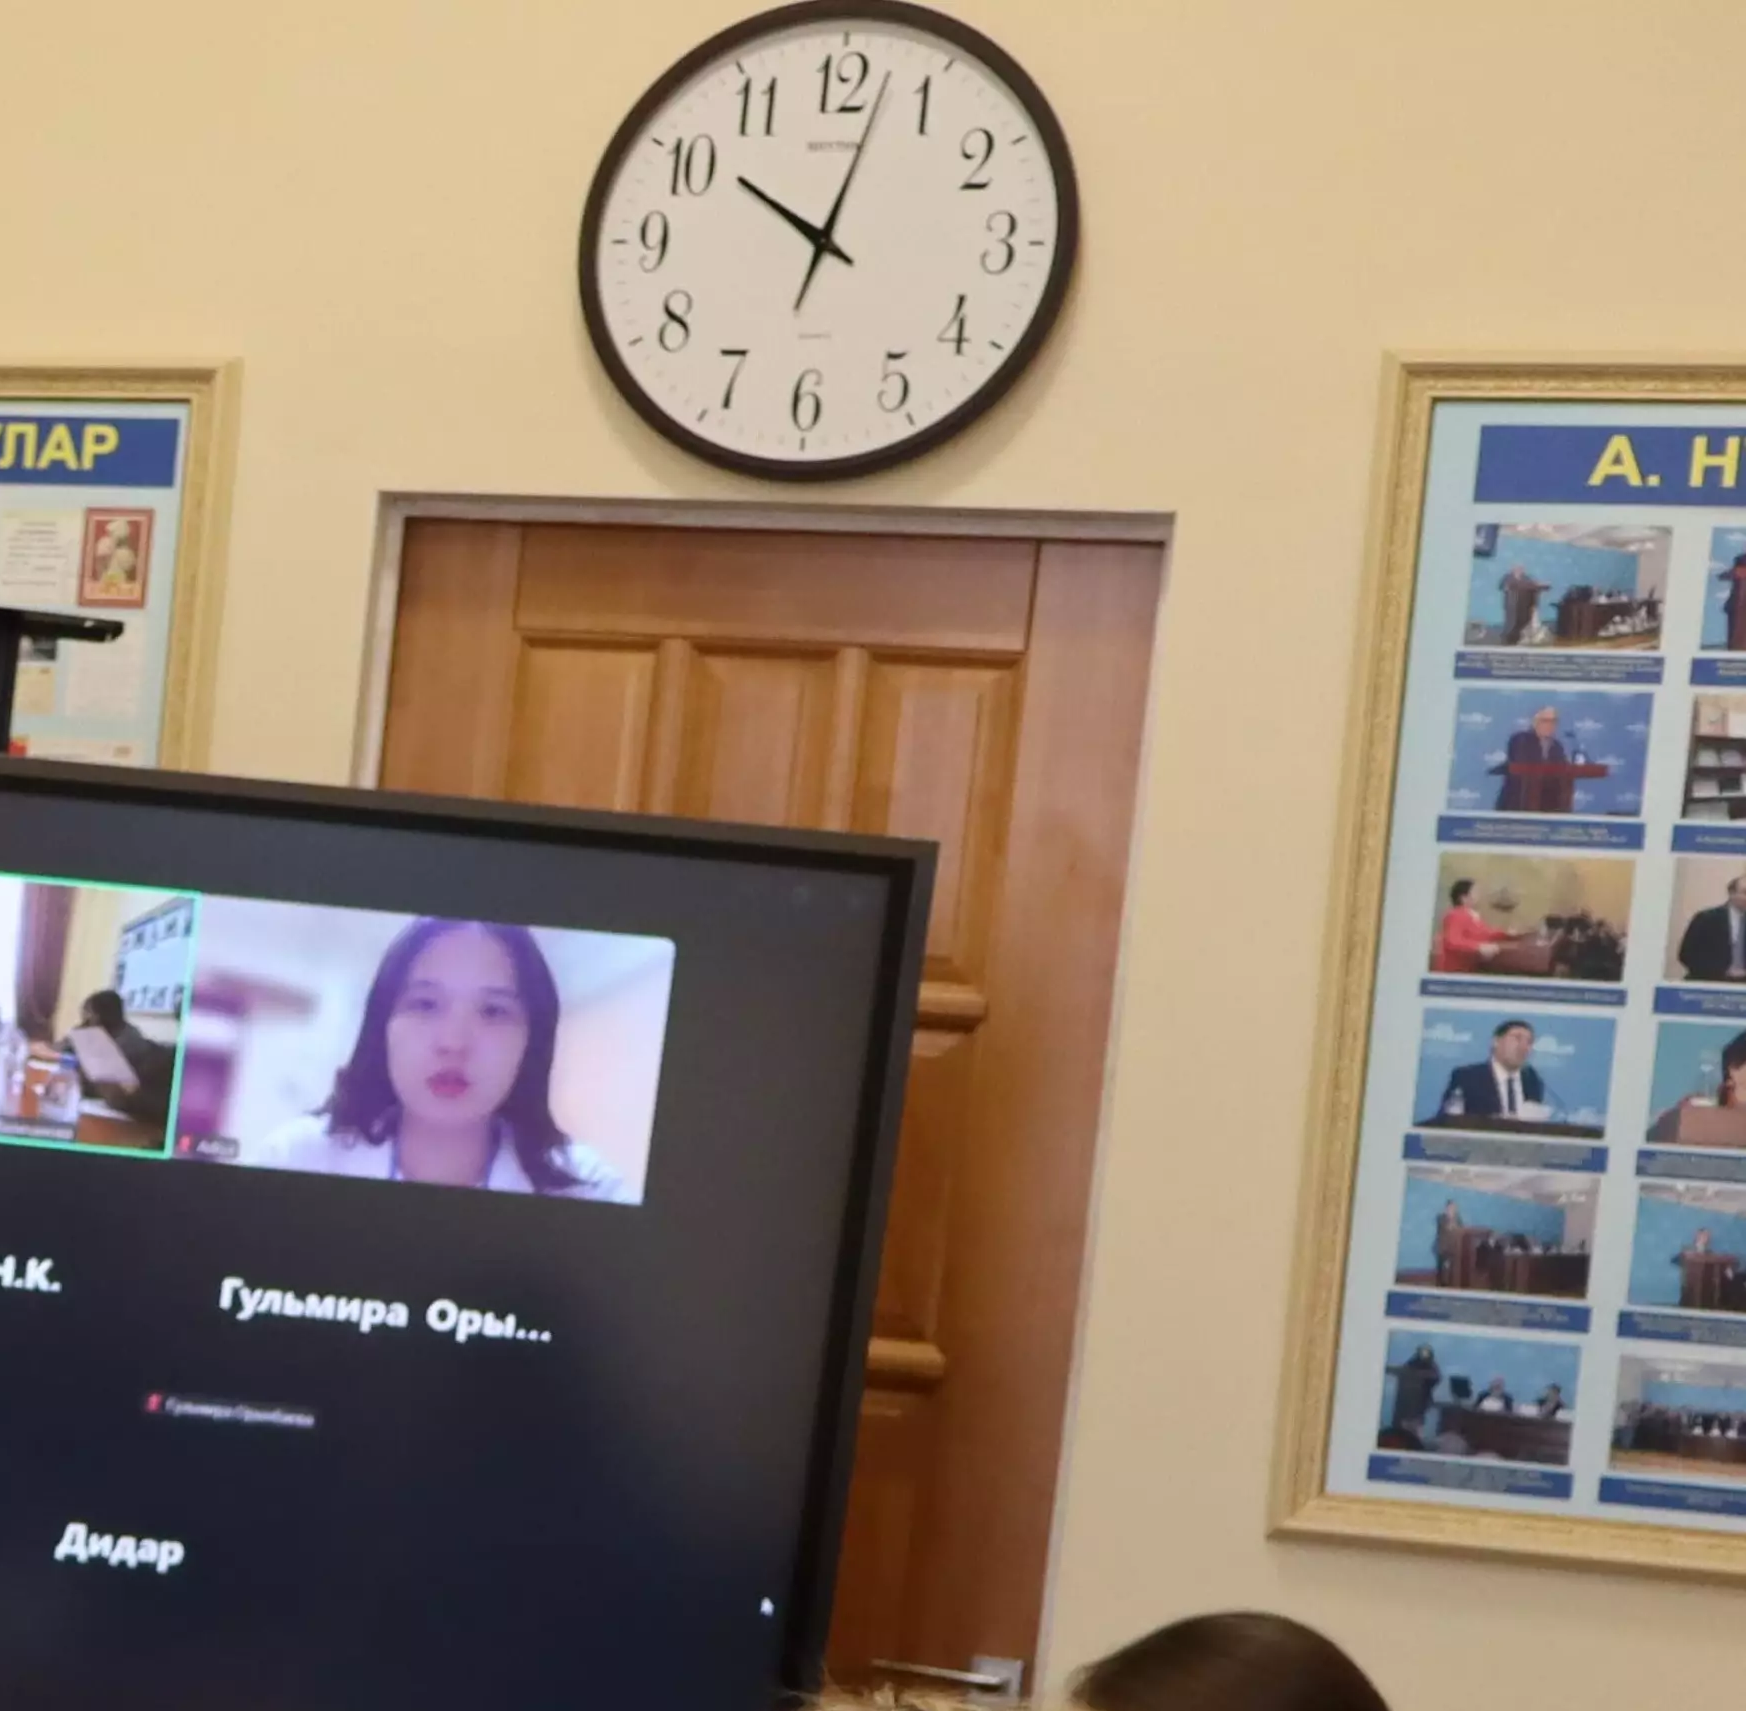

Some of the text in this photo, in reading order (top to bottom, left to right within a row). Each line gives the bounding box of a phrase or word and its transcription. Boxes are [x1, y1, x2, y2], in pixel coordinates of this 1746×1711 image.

[735, 75, 778, 137] 11
[815, 51, 870, 115] 12
[913, 74, 933, 136] 1
[668, 132, 717, 197] 10
[959, 127, 995, 191] 2
[638, 210, 670, 273] 9
[979, 210, 1018, 276] 3
[657, 288, 693, 353] 8
[936, 293, 972, 356] 4
[719, 348, 750, 410] 7
[790, 368, 824, 433] 6
[877, 350, 911, 413] 5
[1586, 434, 1746, 488] А. Н
[218, 1276, 410, 1334] Гульмира
[54, 1520, 185, 1573] Дидар
